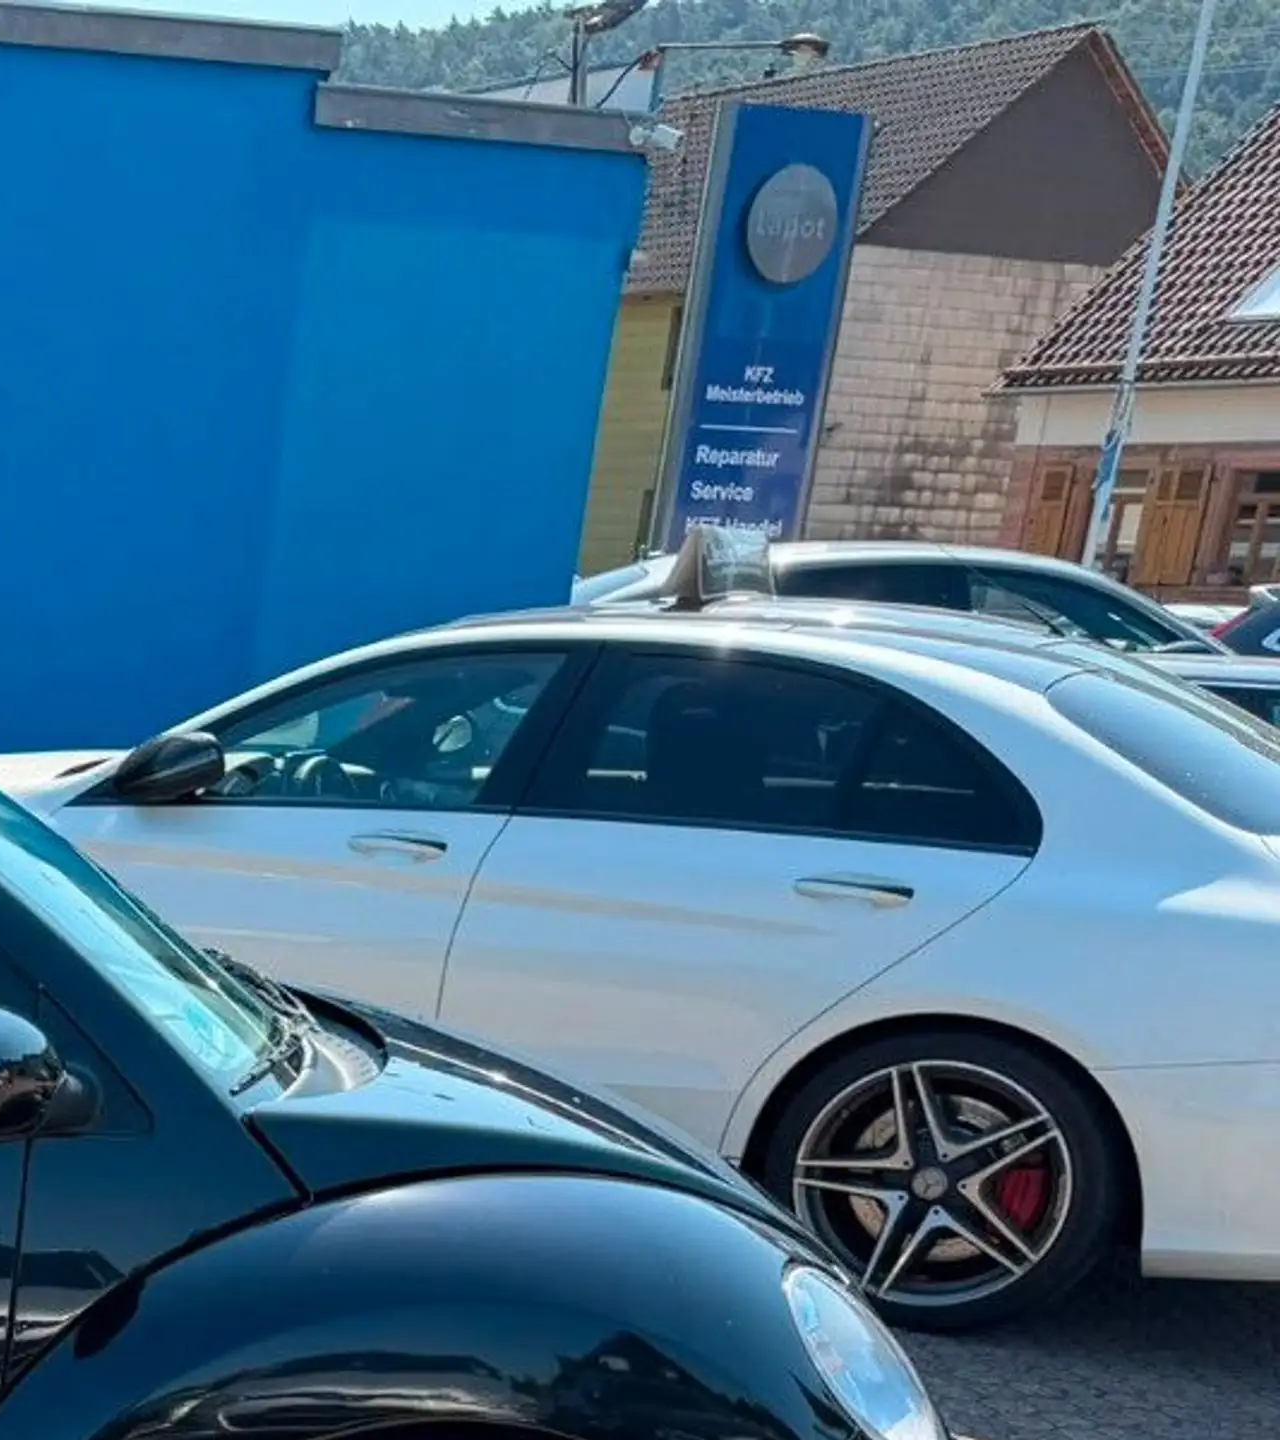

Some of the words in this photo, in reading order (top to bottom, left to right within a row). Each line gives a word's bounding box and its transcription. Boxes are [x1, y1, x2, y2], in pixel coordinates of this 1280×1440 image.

[744, 365, 774, 382] KFZ
[705, 384, 804, 406] Meisterbetrieb
[696, 444, 780, 468] Reparatur
[690, 480, 754, 501] Service
